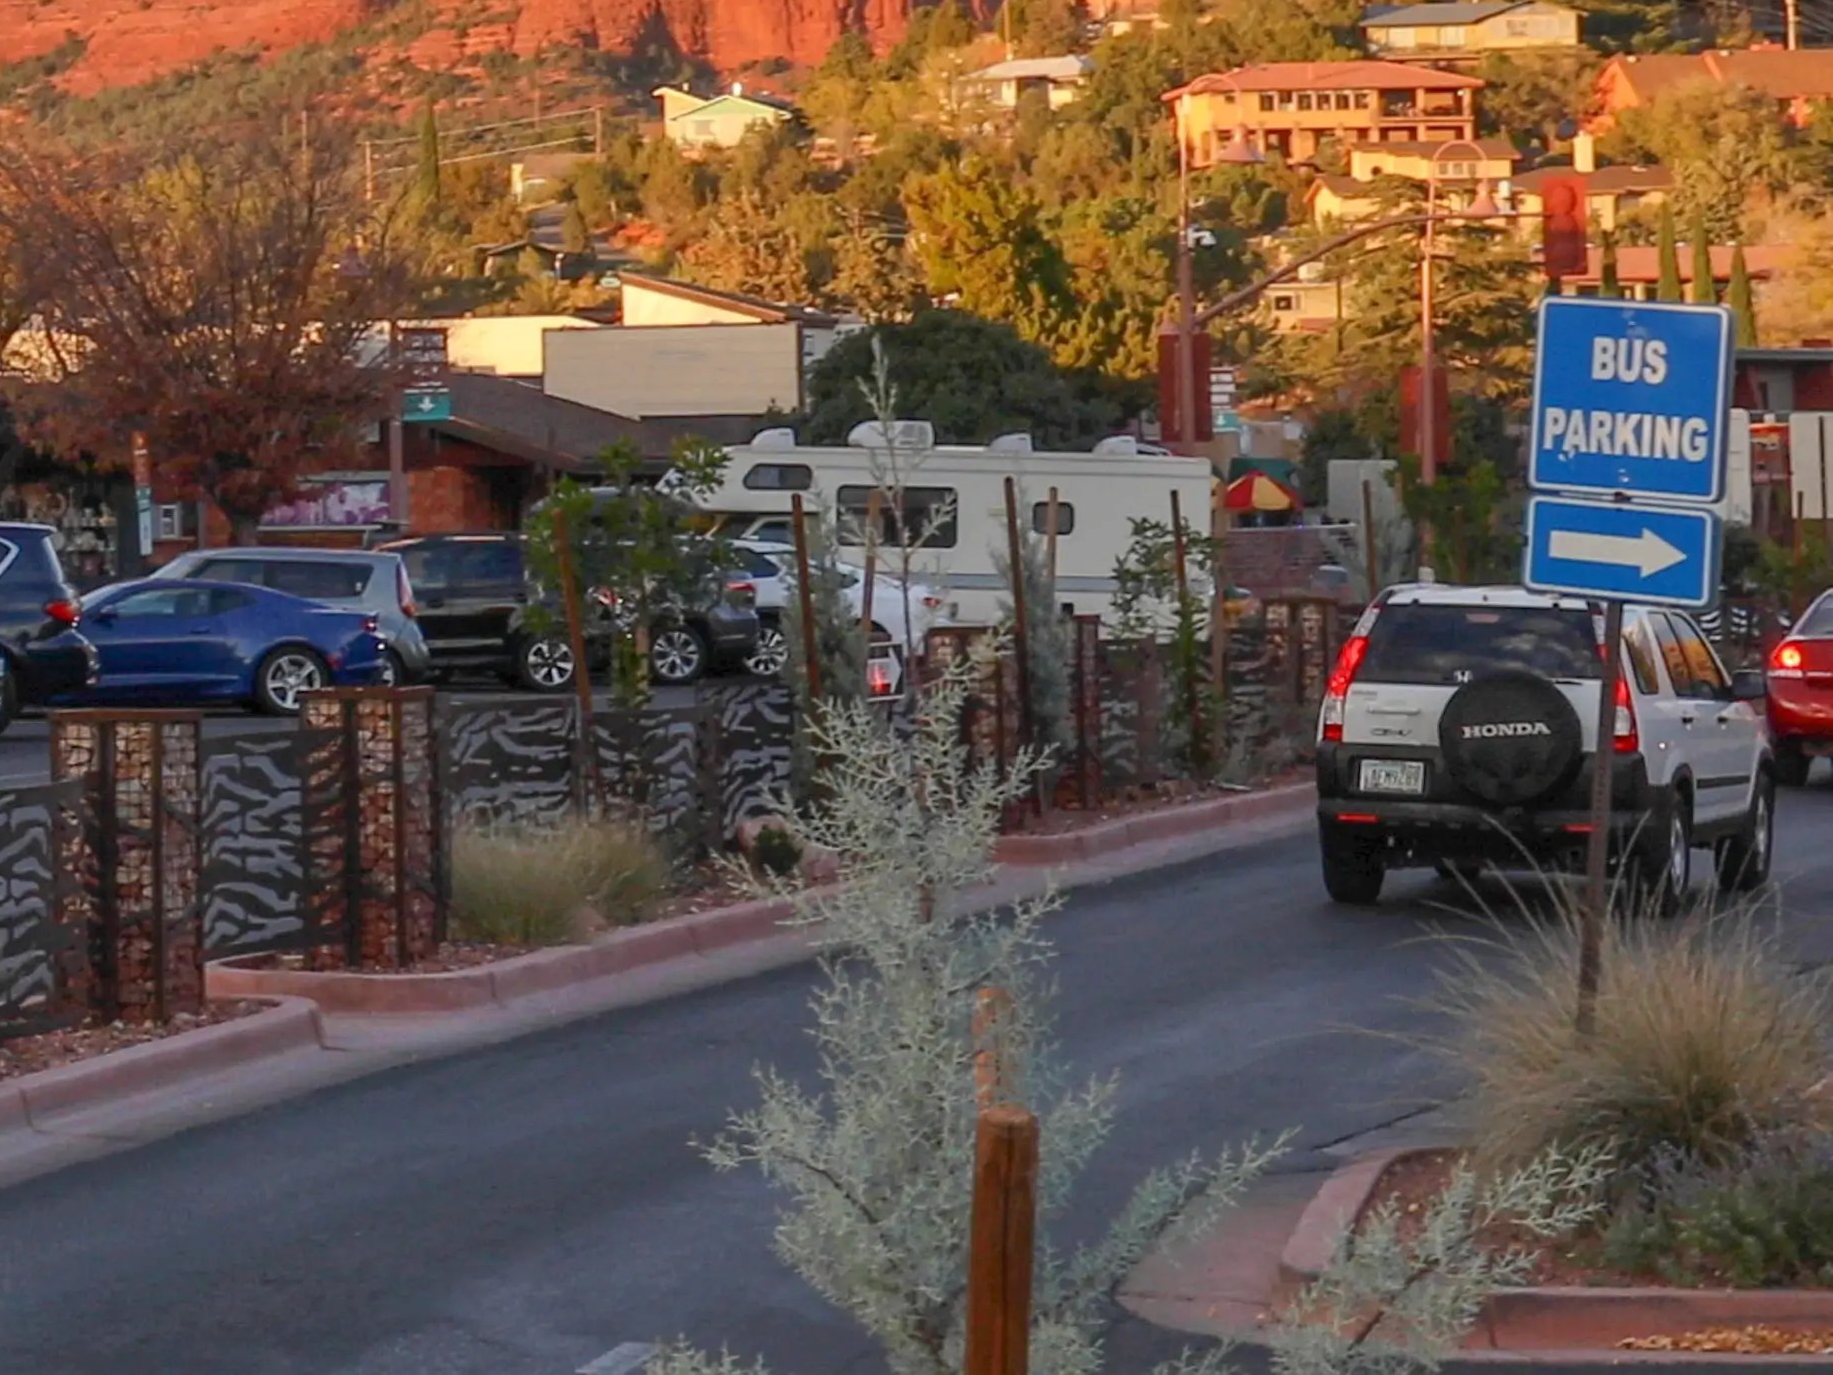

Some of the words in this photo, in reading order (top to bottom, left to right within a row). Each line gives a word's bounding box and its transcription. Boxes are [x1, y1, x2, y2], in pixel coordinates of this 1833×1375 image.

[1591, 336, 1668, 385] BUS
[1542, 406, 1709, 463] PARKING
[1461, 722, 1551, 739] HONDA
